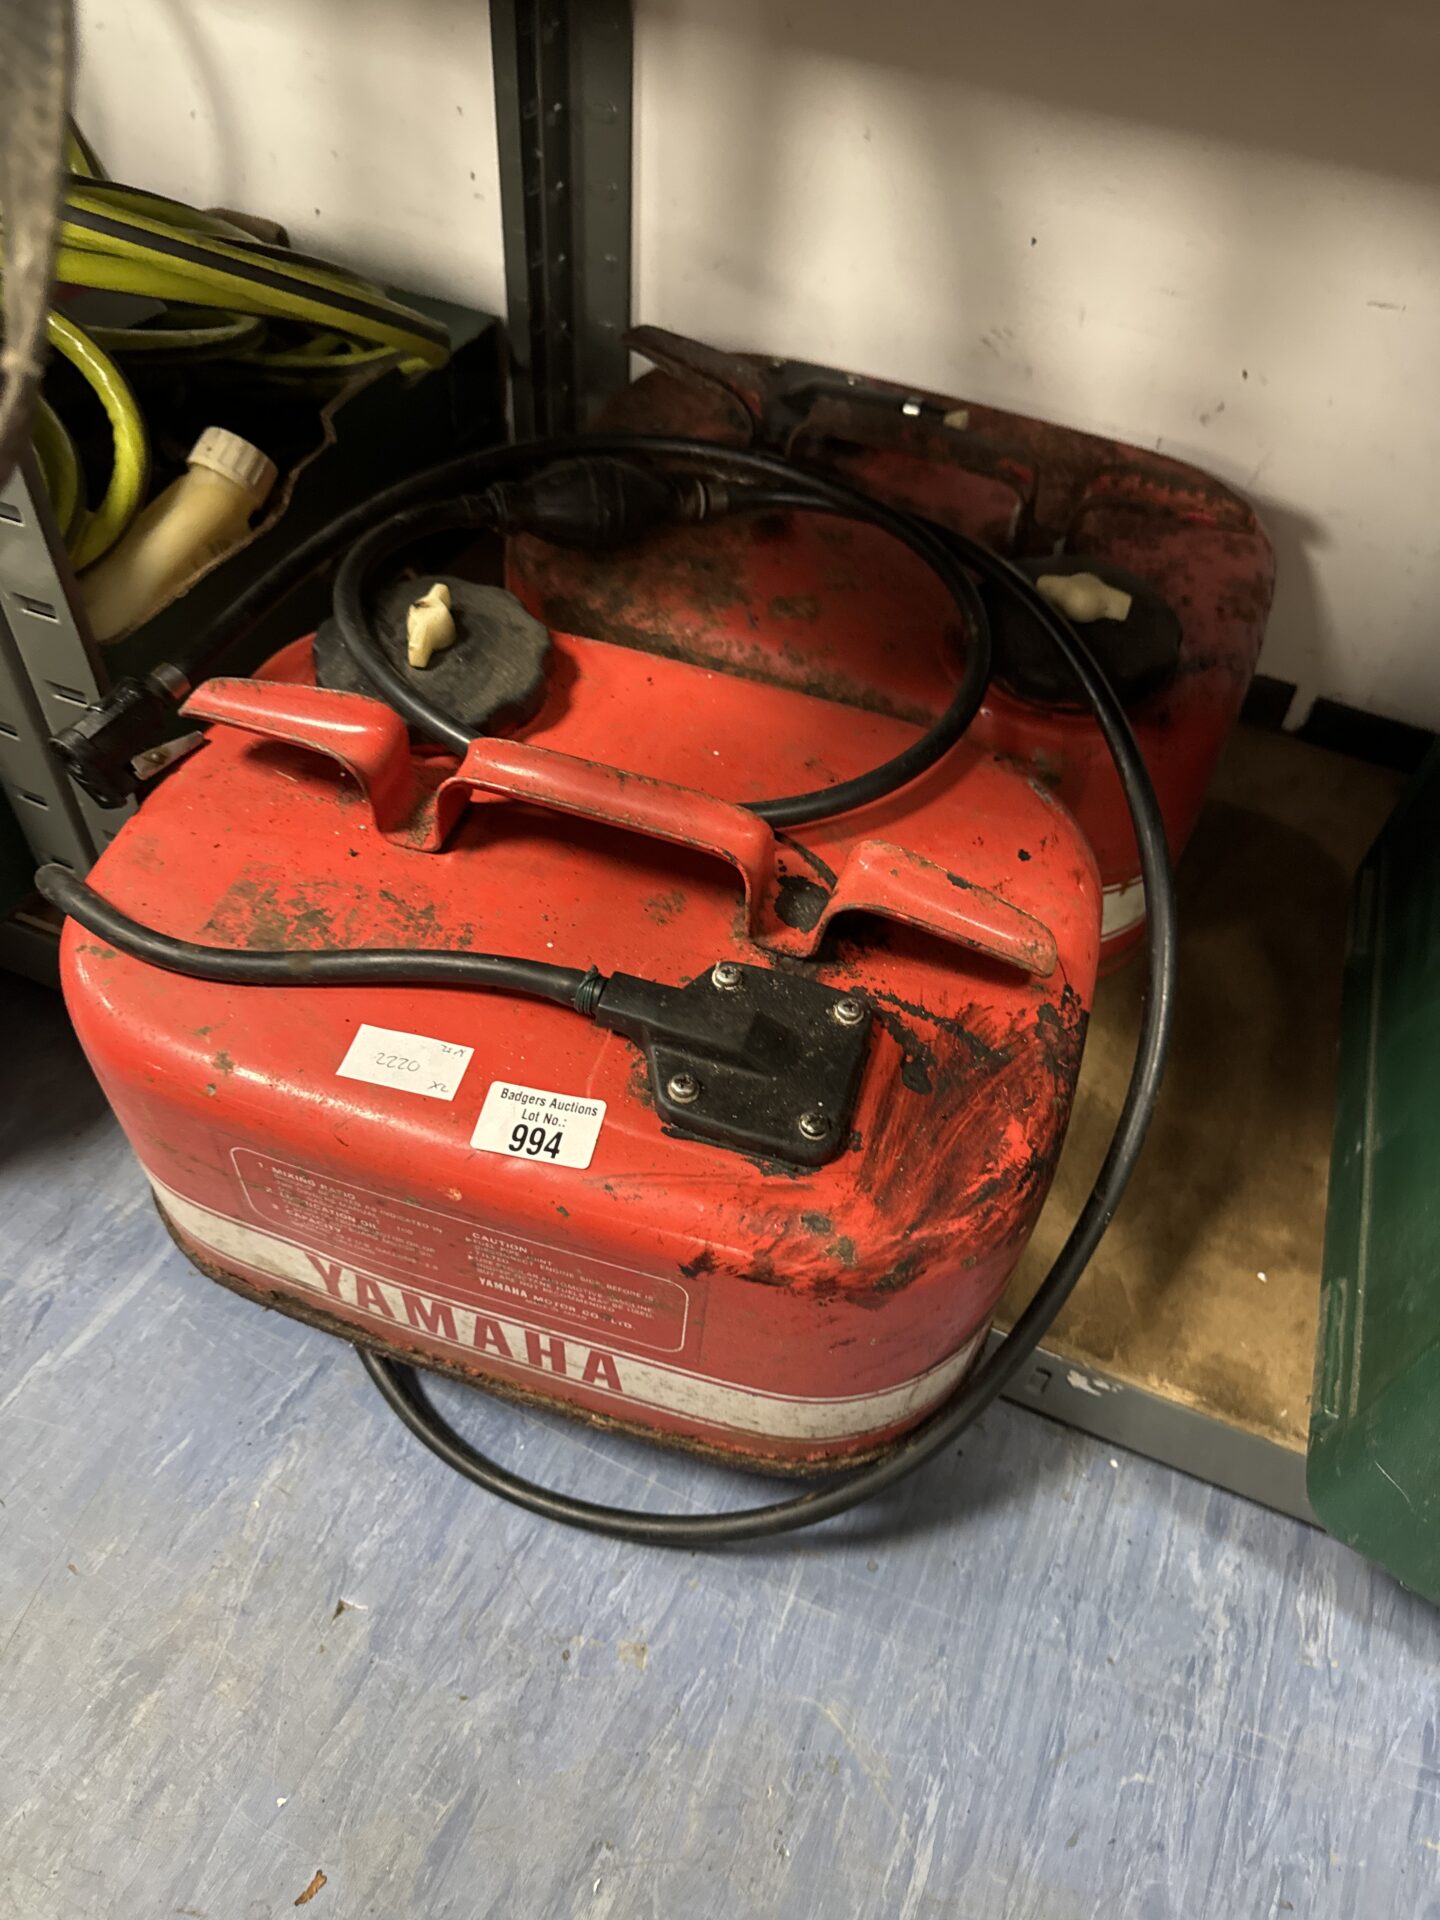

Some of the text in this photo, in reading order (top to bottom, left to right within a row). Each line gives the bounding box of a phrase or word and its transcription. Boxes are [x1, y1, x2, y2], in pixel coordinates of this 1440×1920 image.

[374, 1052, 421, 1073] 2220
[500, 1087, 599, 1117] Badgers Auctions
[521, 1108, 567, 1128] Lot No.:
[508, 1123, 563, 1159] 994
[272, 1166, 316, 1187] MIXING
[320, 1183, 356, 1200] RATIO
[284, 1208, 341, 1232] CAPACITY
[359, 1220, 376, 1229] OIL
[379, 1210, 429, 1228] INDICATED
[478, 1277, 527, 1297] YAMAHA
[532, 1294, 575, 1312] MOTOR
[539, 1264, 573, 1278] ENGINE
[606, 1283, 640, 1298] BEFORE
[304, 1251, 624, 1393] YAMAHA
